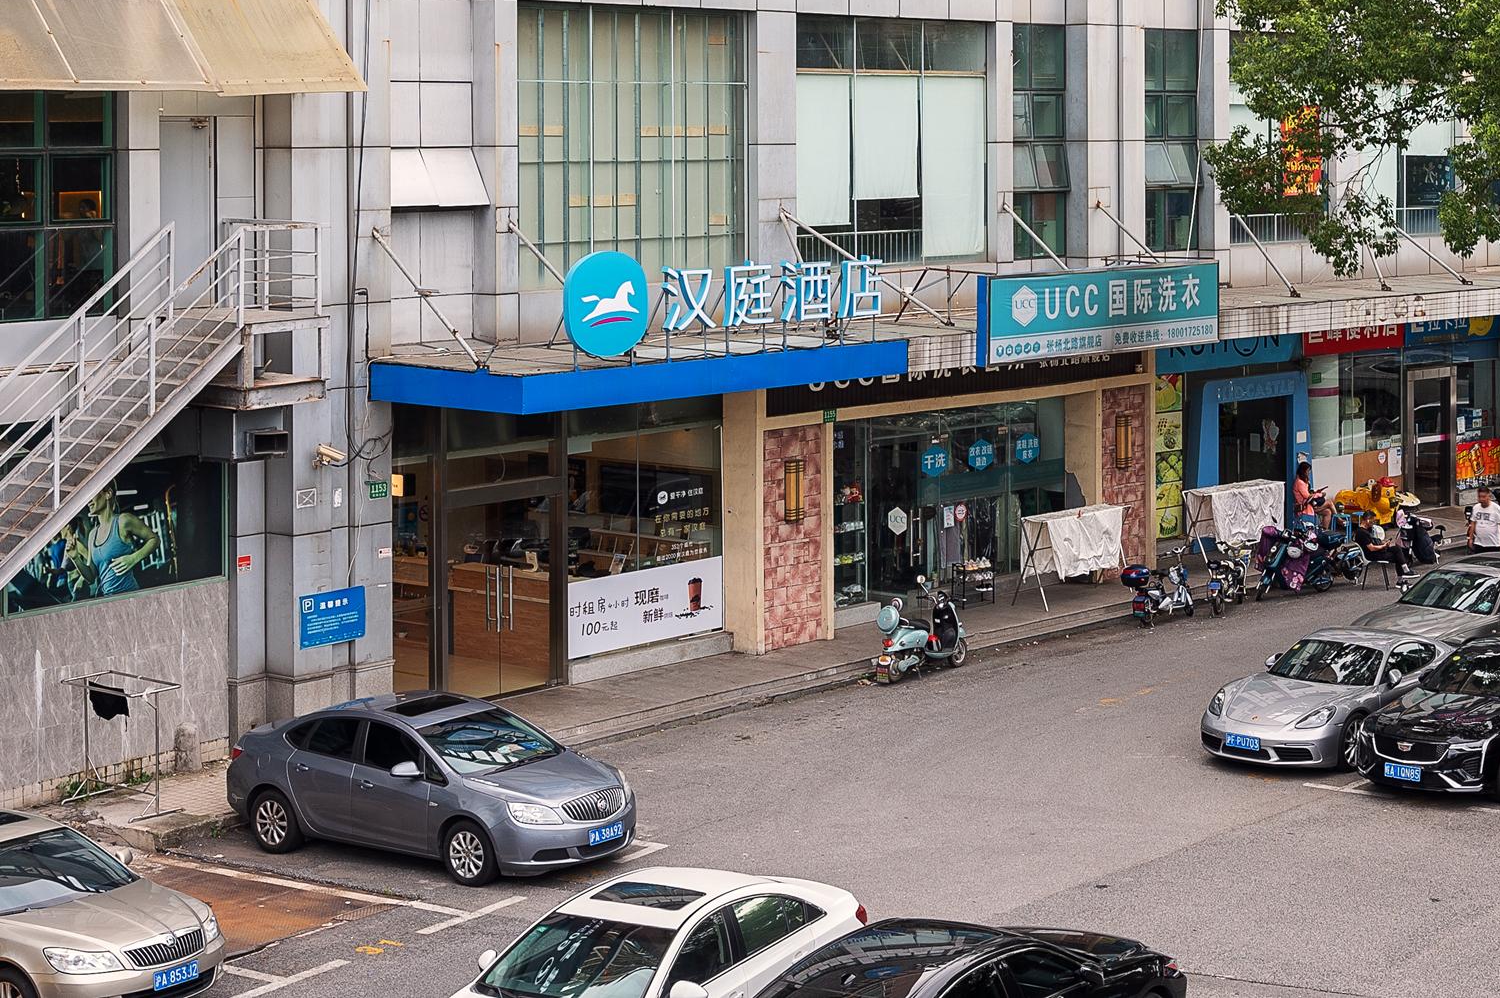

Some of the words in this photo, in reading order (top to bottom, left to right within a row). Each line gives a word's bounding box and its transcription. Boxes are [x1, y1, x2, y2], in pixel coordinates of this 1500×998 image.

[661, 254, 883, 331] 汉庭酒店
[1013, 298, 1036, 310] UCC
[1046, 334, 1102, 354] 张杨北路旗舰店
[924, 453, 945, 469] 干洗
[371, 483, 386, 493] 1153
[889, 514, 907, 524] UCC
